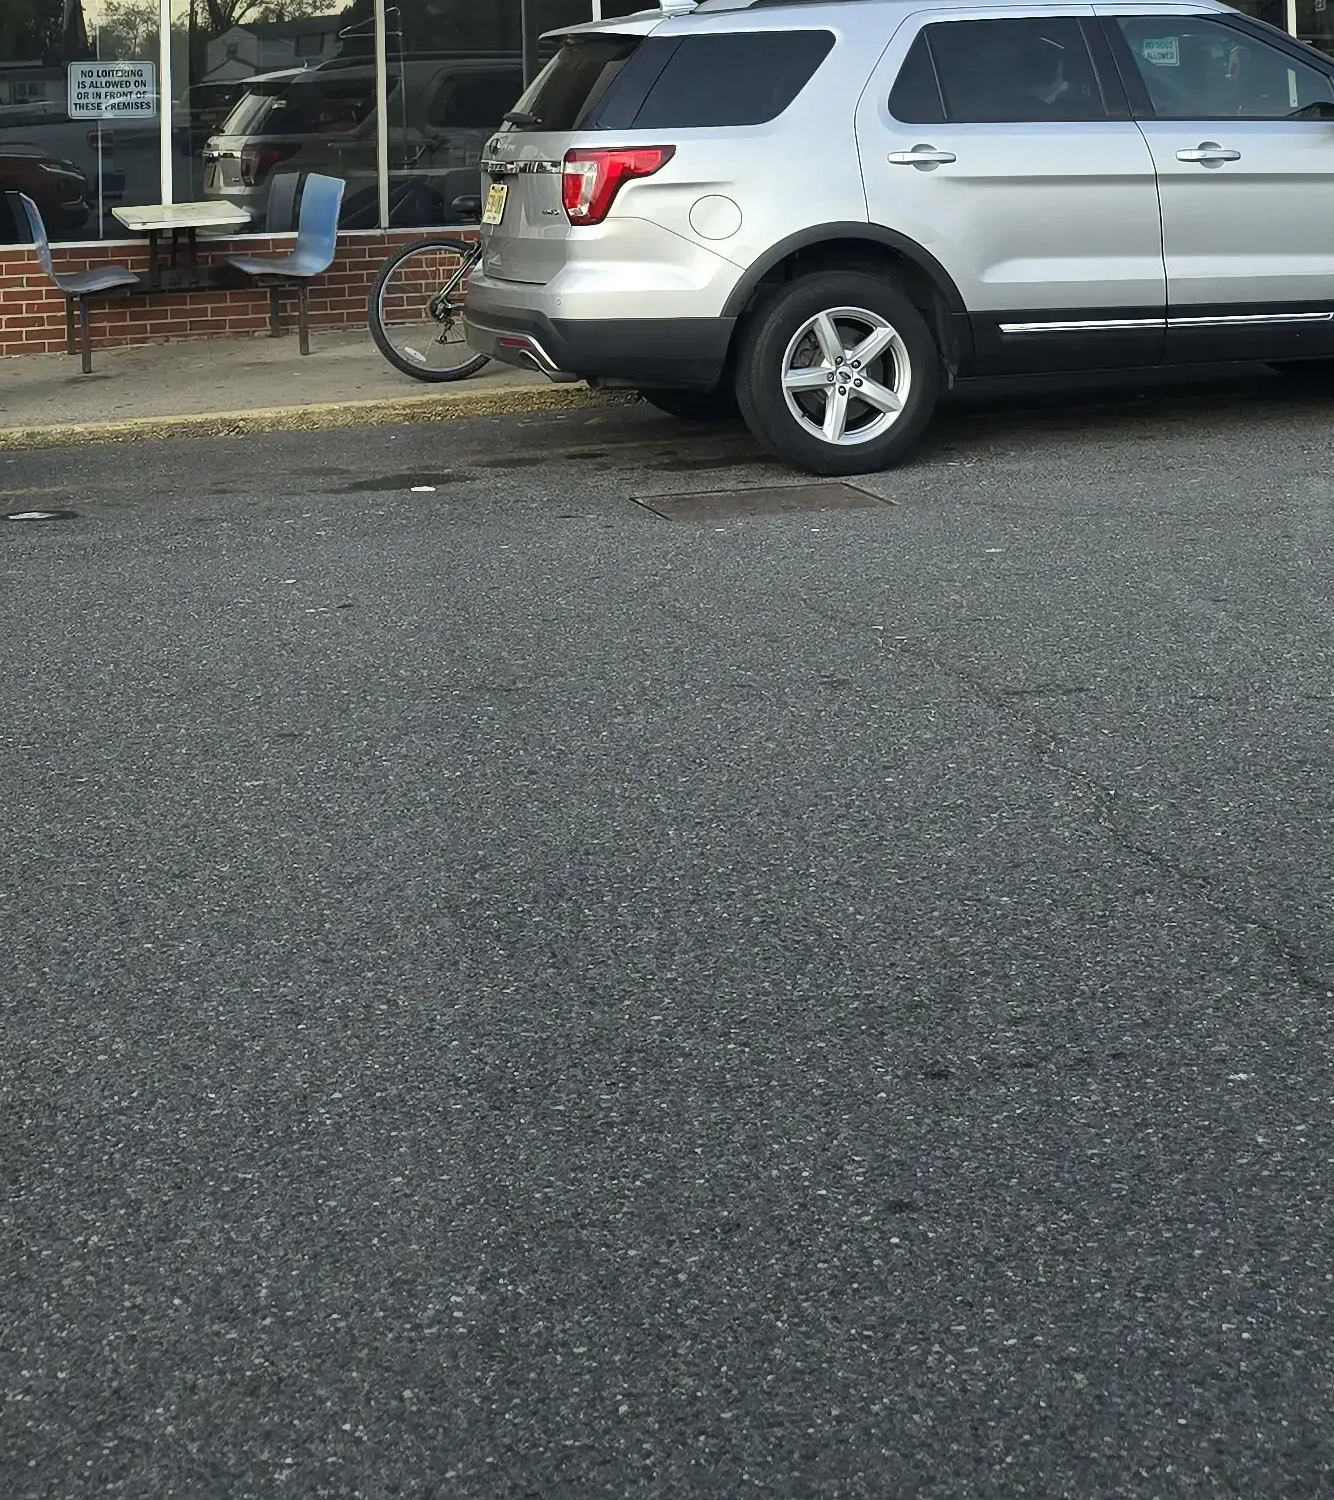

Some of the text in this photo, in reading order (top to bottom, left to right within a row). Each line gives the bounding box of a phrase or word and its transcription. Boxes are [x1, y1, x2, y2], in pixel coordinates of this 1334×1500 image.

[80, 69, 144, 78] NO LOITERING
[77, 79, 147, 89] IS ALLOWED ON
[76, 91, 89, 100] OR
[92, 91, 102, 100] IN
[104, 91, 134, 100] FRONT
[73, 102, 103, 112] THESE
